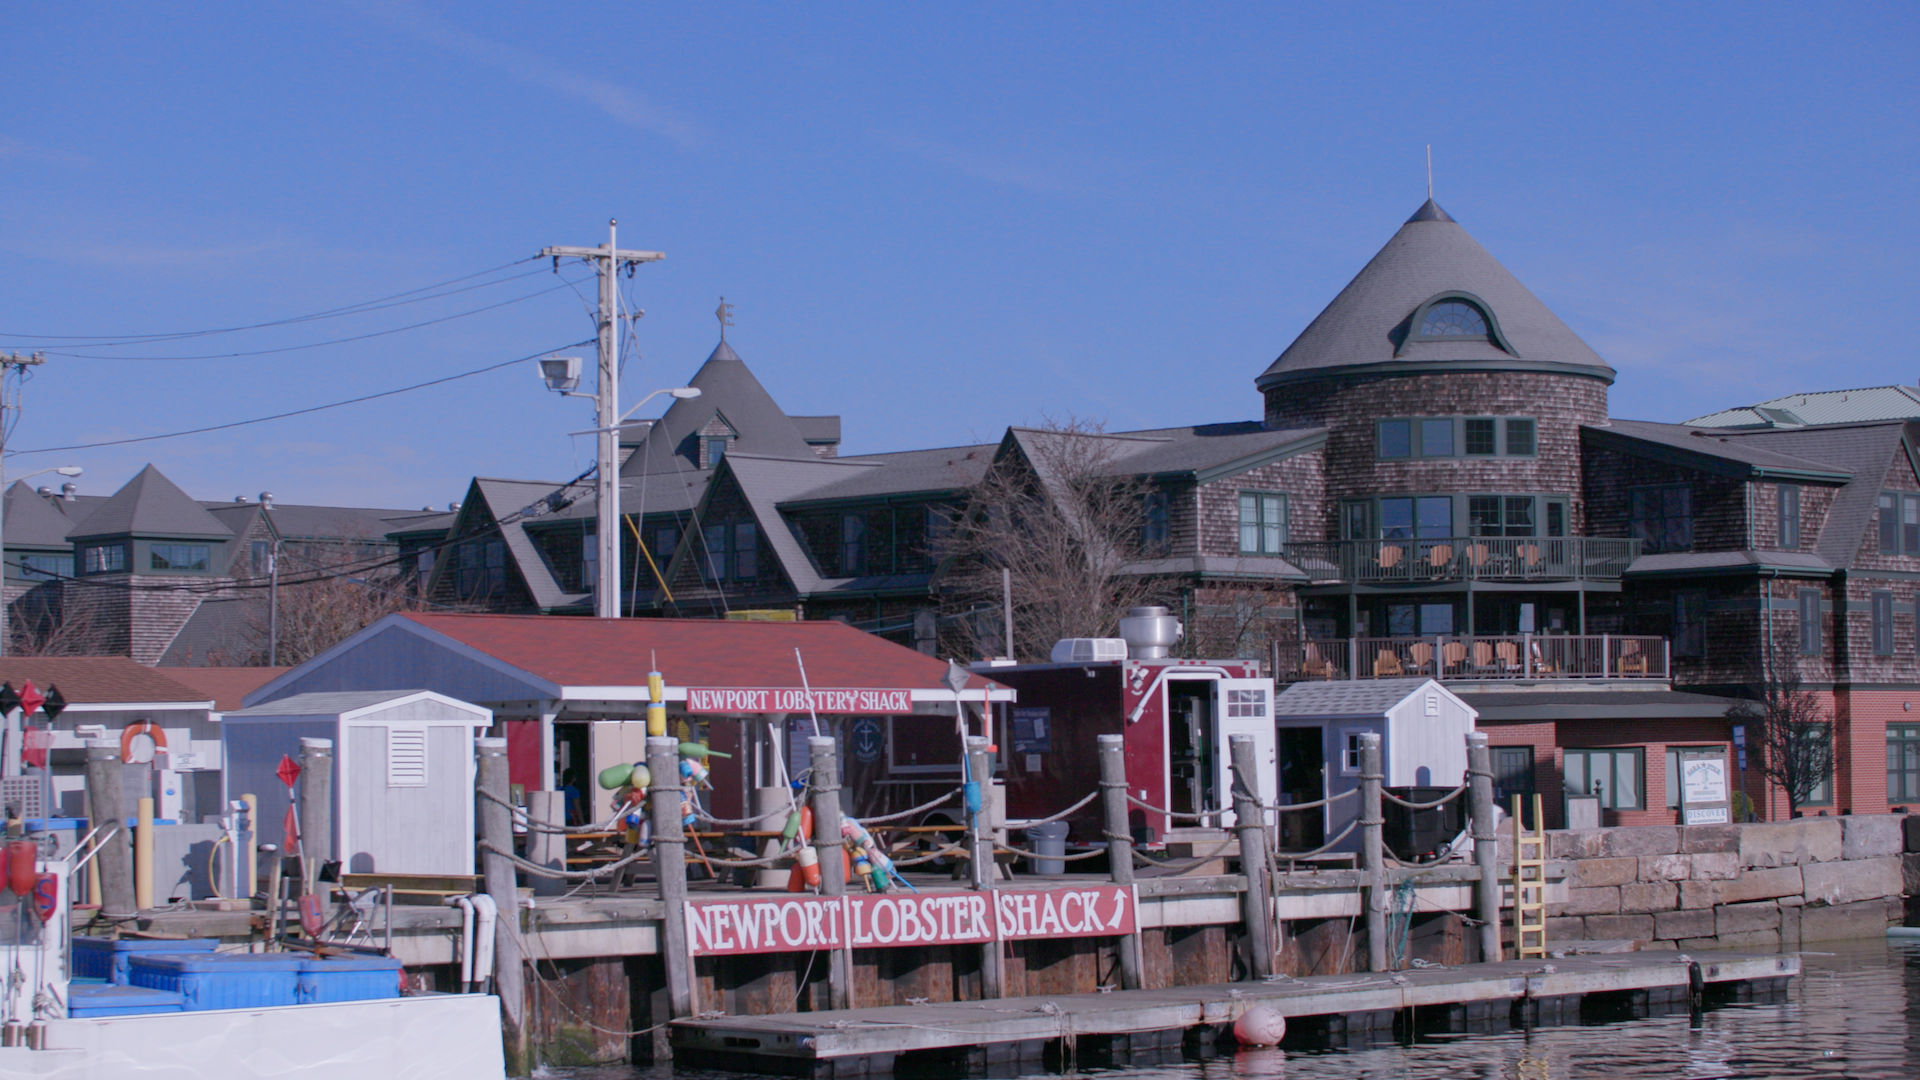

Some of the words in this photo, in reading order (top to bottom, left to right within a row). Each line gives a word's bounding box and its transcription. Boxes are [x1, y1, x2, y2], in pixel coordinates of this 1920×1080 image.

[690, 690, 769, 710] NEWPORT
[775, 690, 846, 710] LOBSTER
[860, 691, 909, 710] SHACK
[1688, 809, 1725, 818] DISCOVER
[37, 878, 54, 909] S
[690, 900, 840, 950] NEWPORT
[851, 895, 991, 943] LOBSTER
[1000, 890, 1105, 937] SHACK
